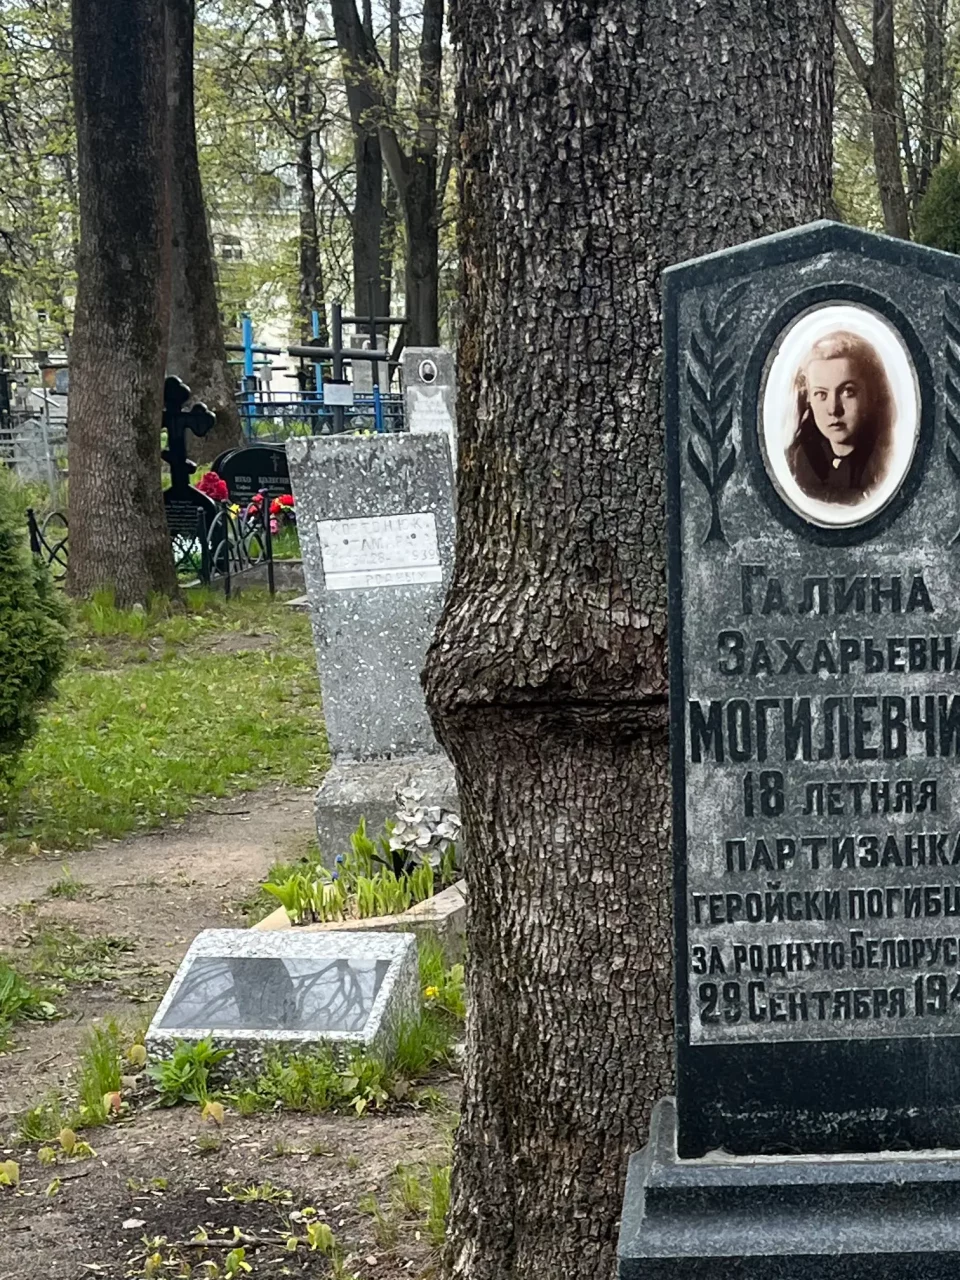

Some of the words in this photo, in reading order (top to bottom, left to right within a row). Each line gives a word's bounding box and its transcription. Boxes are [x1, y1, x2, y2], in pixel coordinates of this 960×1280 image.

[743, 770, 784, 818] 18
[802, 778, 938, 816] ЛЕТНЯЯ
[692, 880, 841, 925] ГЕРОЙСКИ
[691, 942, 726, 975] ЗА
[734, 940, 845, 978] РОДНУЮ
[699, 980, 742, 1025] 29
[748, 979, 907, 1023] СЕНТЯБРЯ
